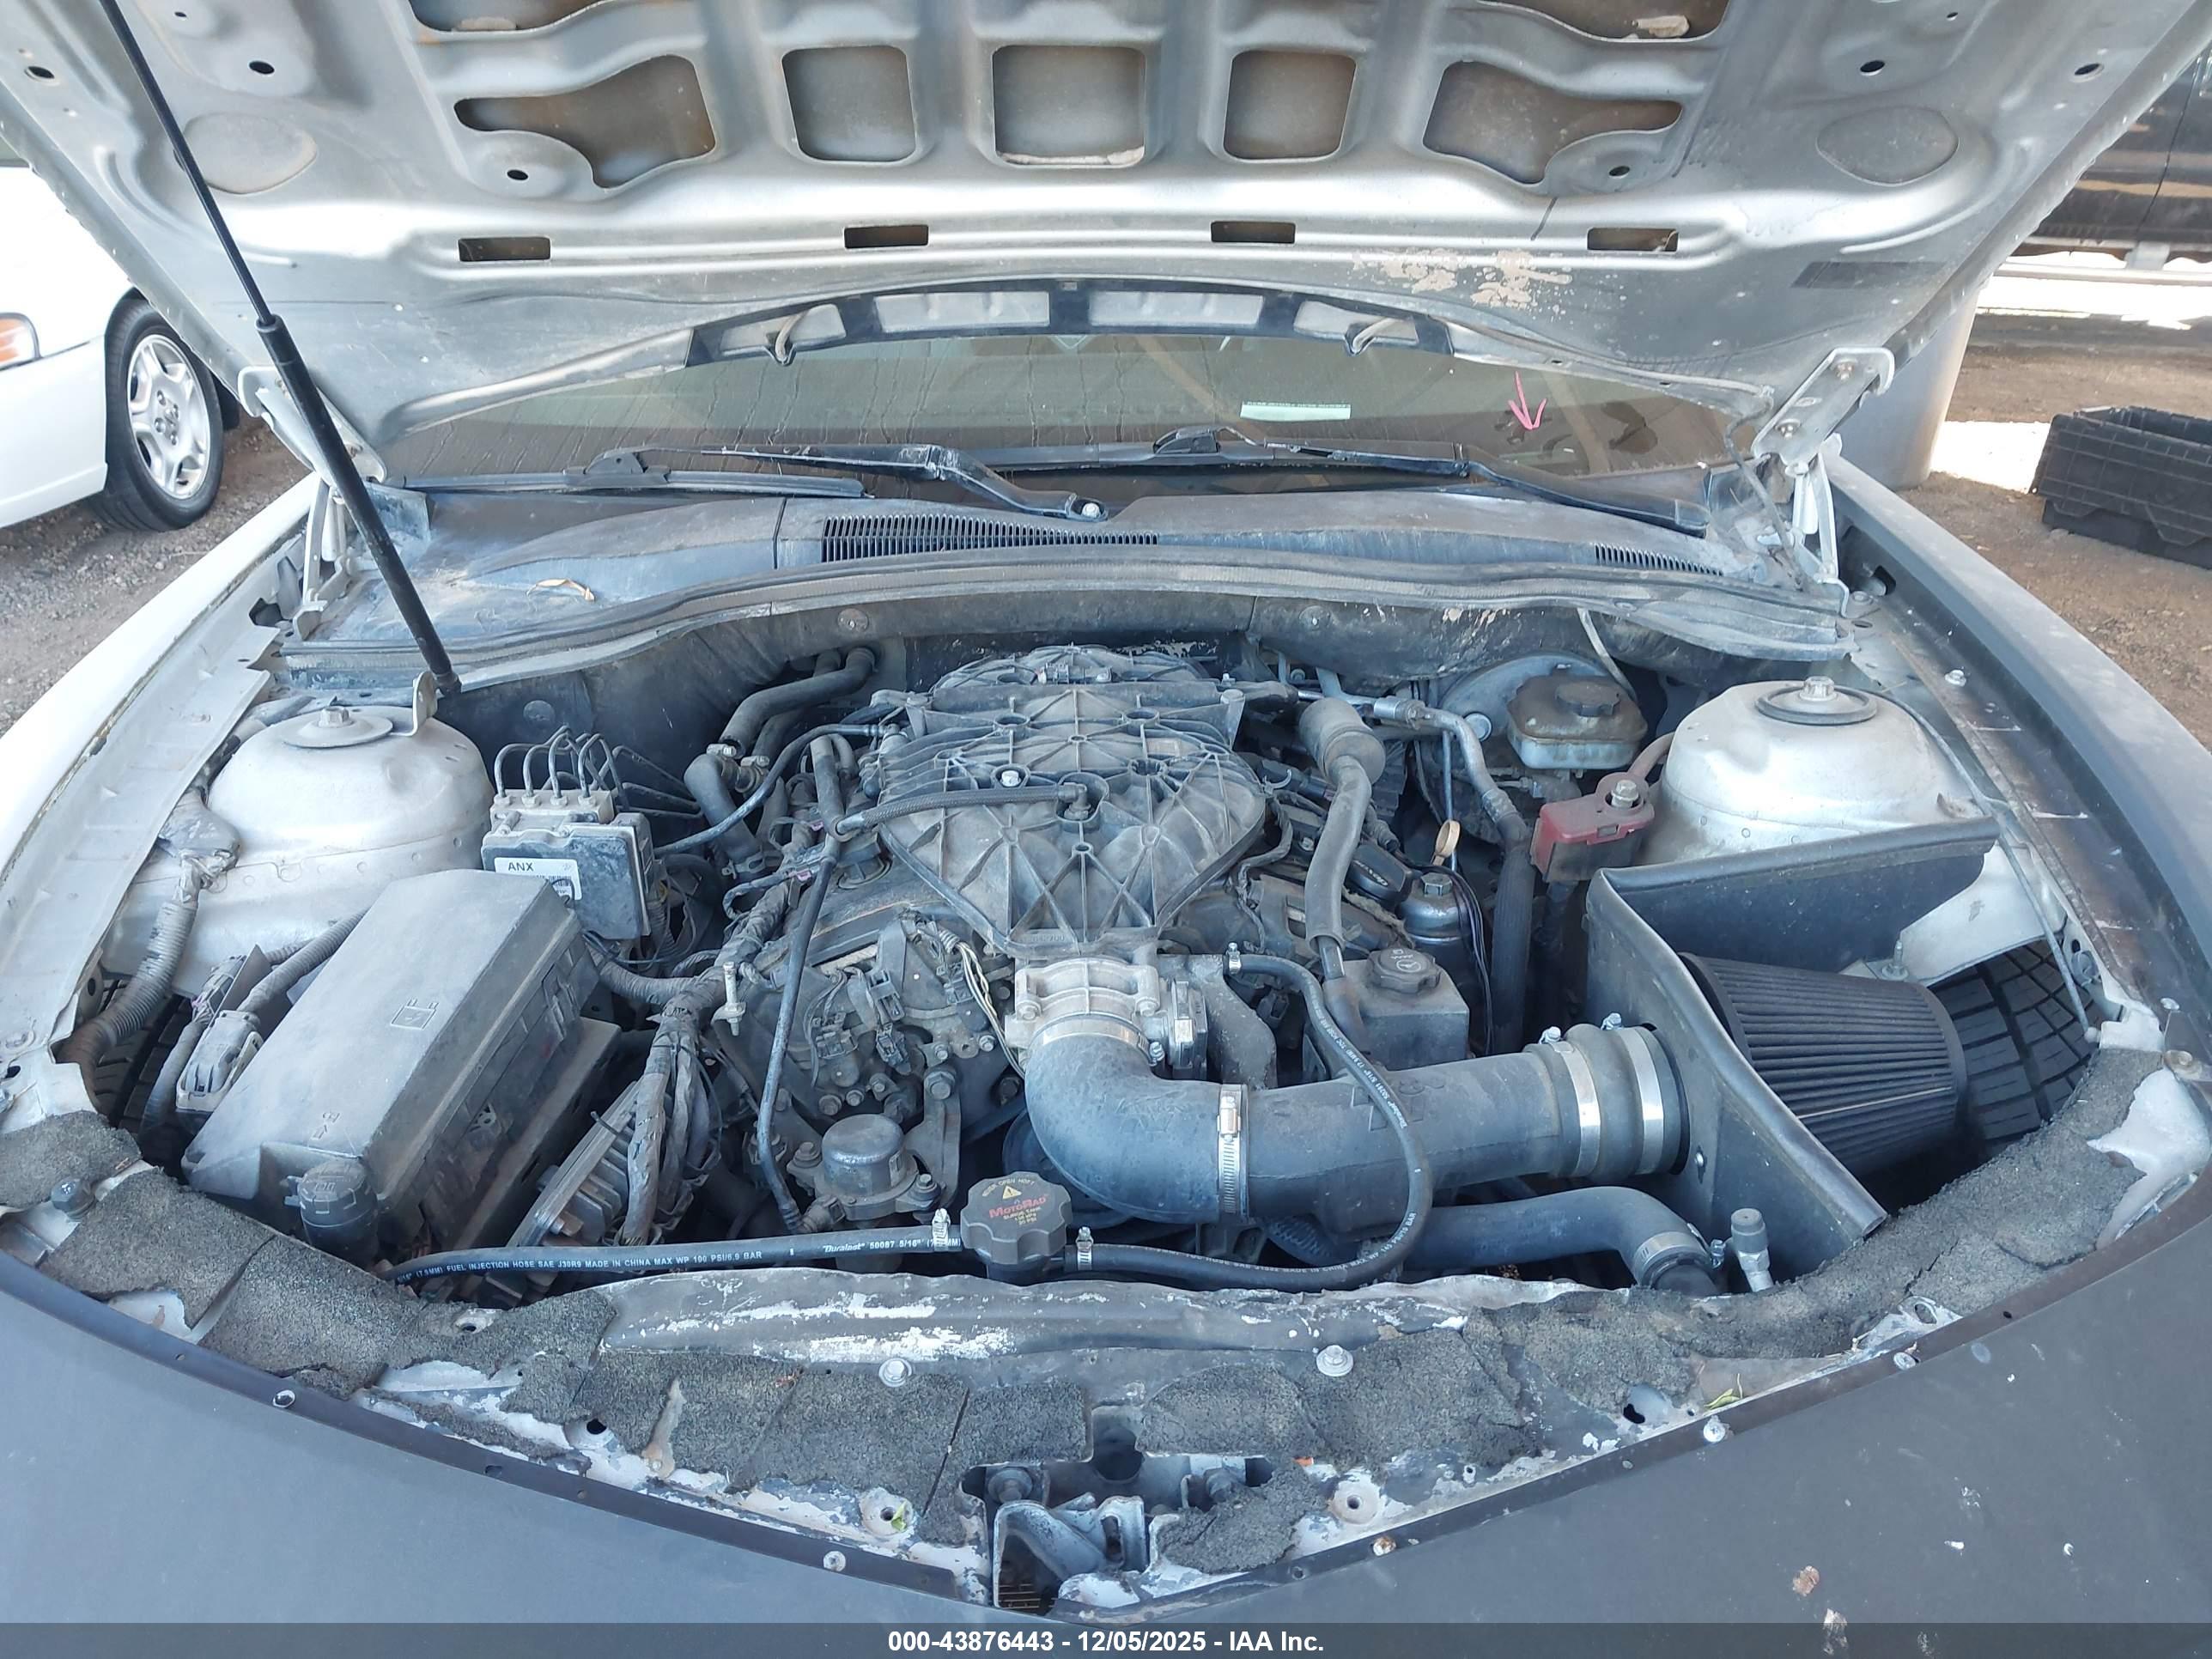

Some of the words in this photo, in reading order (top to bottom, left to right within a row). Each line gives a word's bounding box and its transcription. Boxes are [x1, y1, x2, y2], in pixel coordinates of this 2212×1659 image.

[508, 862, 534, 872] ANX
[1406, 1212, 1417, 1226] BAR
[585, 1260, 609, 1268] MADE
[612, 1259, 621, 1267] IN
[624, 1258, 652, 1267] CHINA
[743, 1251, 763, 1260] BAR
